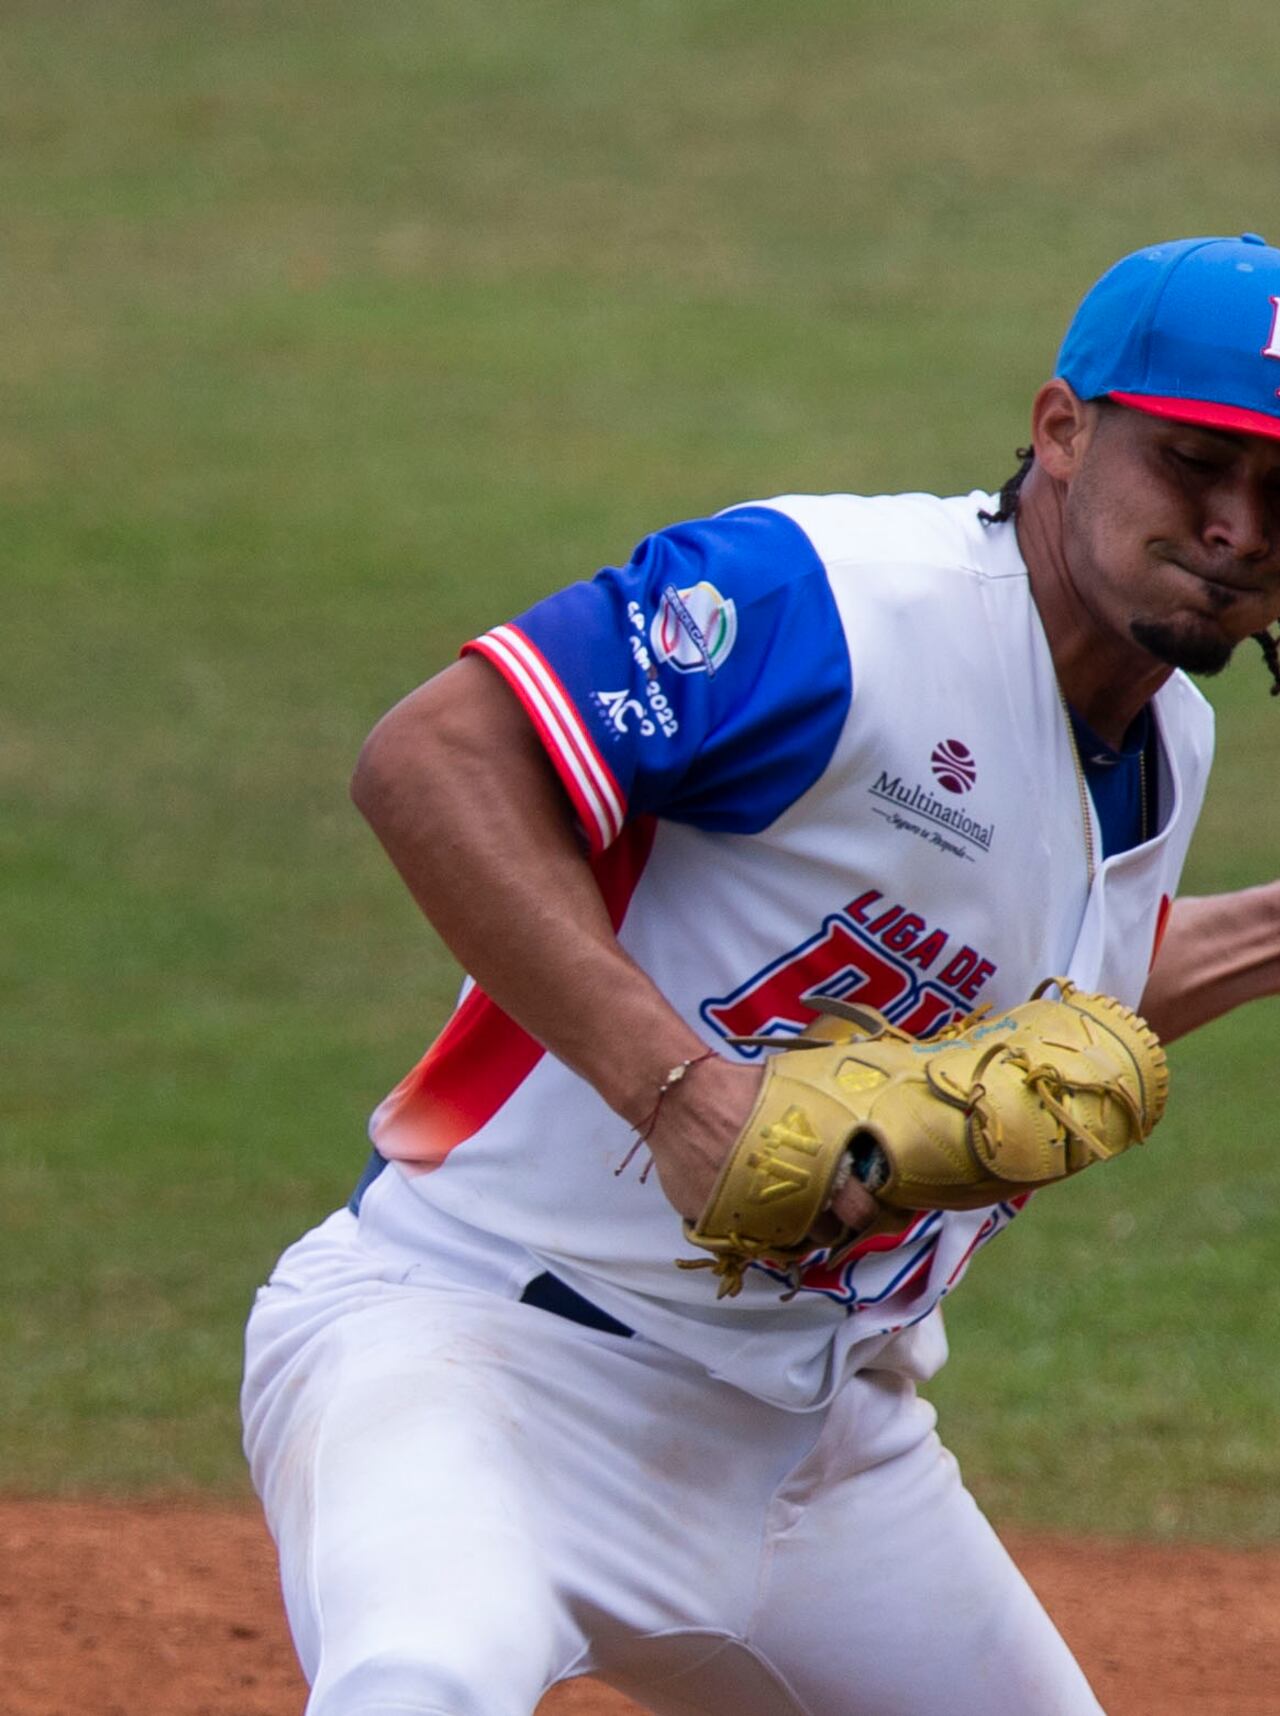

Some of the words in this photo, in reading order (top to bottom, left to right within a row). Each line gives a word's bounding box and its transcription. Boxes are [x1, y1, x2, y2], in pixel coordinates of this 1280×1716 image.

[646, 681, 679, 739] 2022
[871, 770, 995, 848] Multinational
[842, 889, 949, 970] LIGA
[936, 945, 998, 1001] DE
